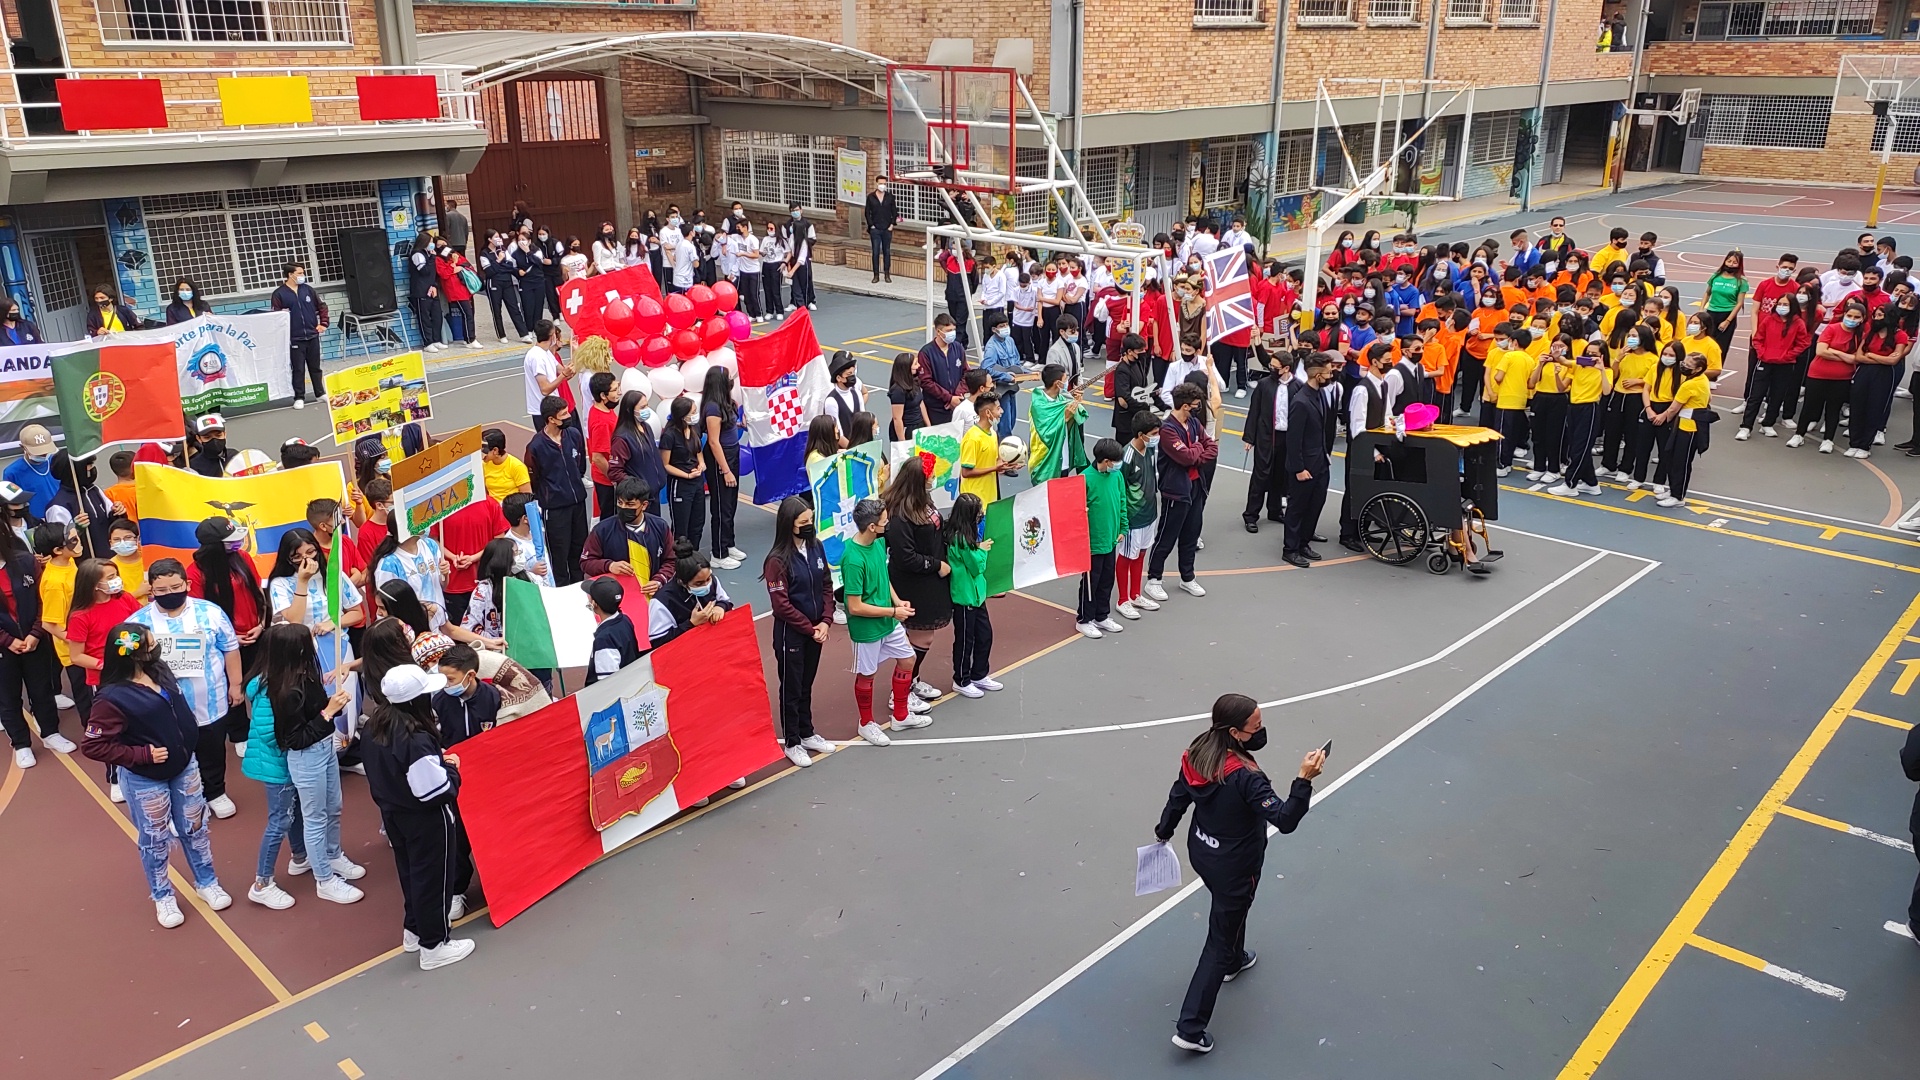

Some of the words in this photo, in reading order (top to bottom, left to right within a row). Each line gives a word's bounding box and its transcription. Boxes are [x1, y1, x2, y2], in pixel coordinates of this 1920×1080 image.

[198, 323, 223, 337] para
[225, 324, 237, 337] la
[237, 331, 257, 351] Paz
[0, 355, 51, 373] ANDA
[191, 393, 211, 404] formo
